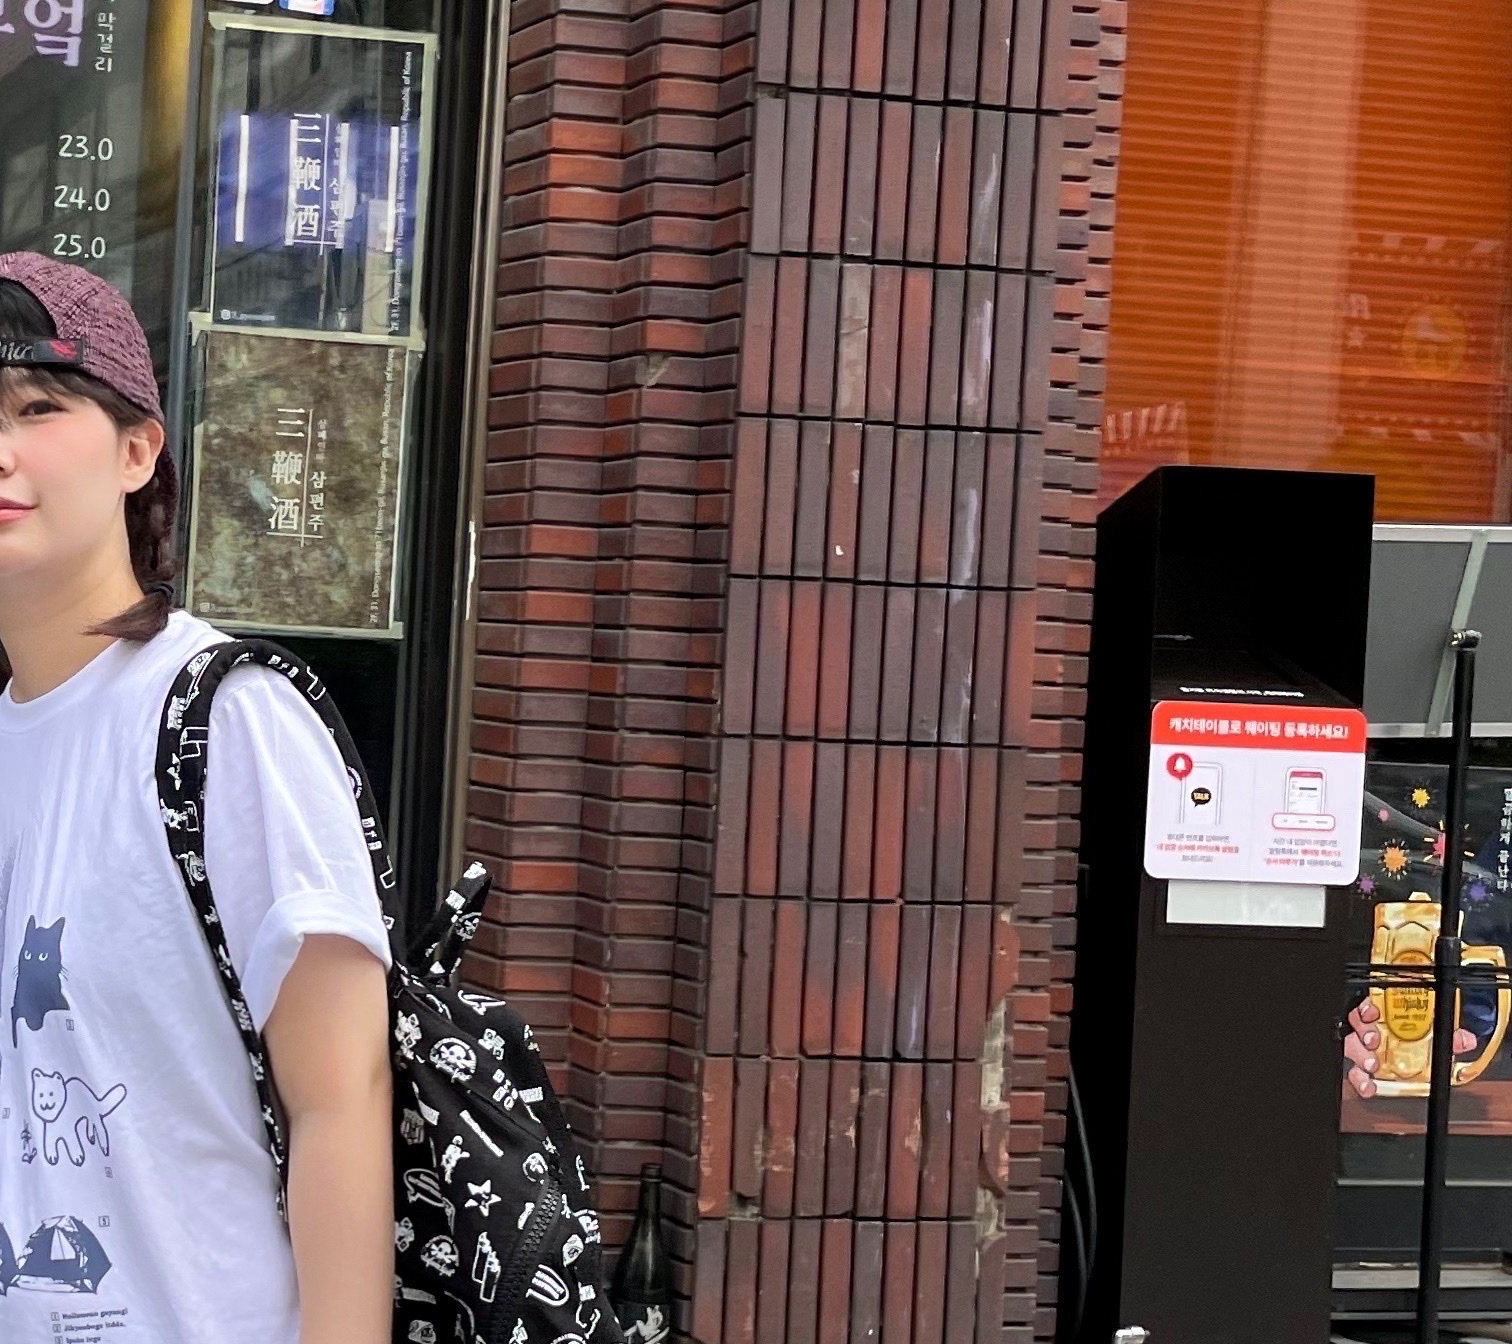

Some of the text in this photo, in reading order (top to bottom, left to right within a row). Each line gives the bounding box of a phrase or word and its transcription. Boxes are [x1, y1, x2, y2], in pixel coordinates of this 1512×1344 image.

[94, 12, 117, 73] 막걸리
[58, 134, 113, 161] 23.0
[54, 185, 111, 212] 24.0
[53, 233, 107, 259] 25.0
[269, 407, 306, 531] 三鞭酒
[307, 471, 327, 532] 삼편주
[1169, 717, 1241, 734] 캐치테이블로
